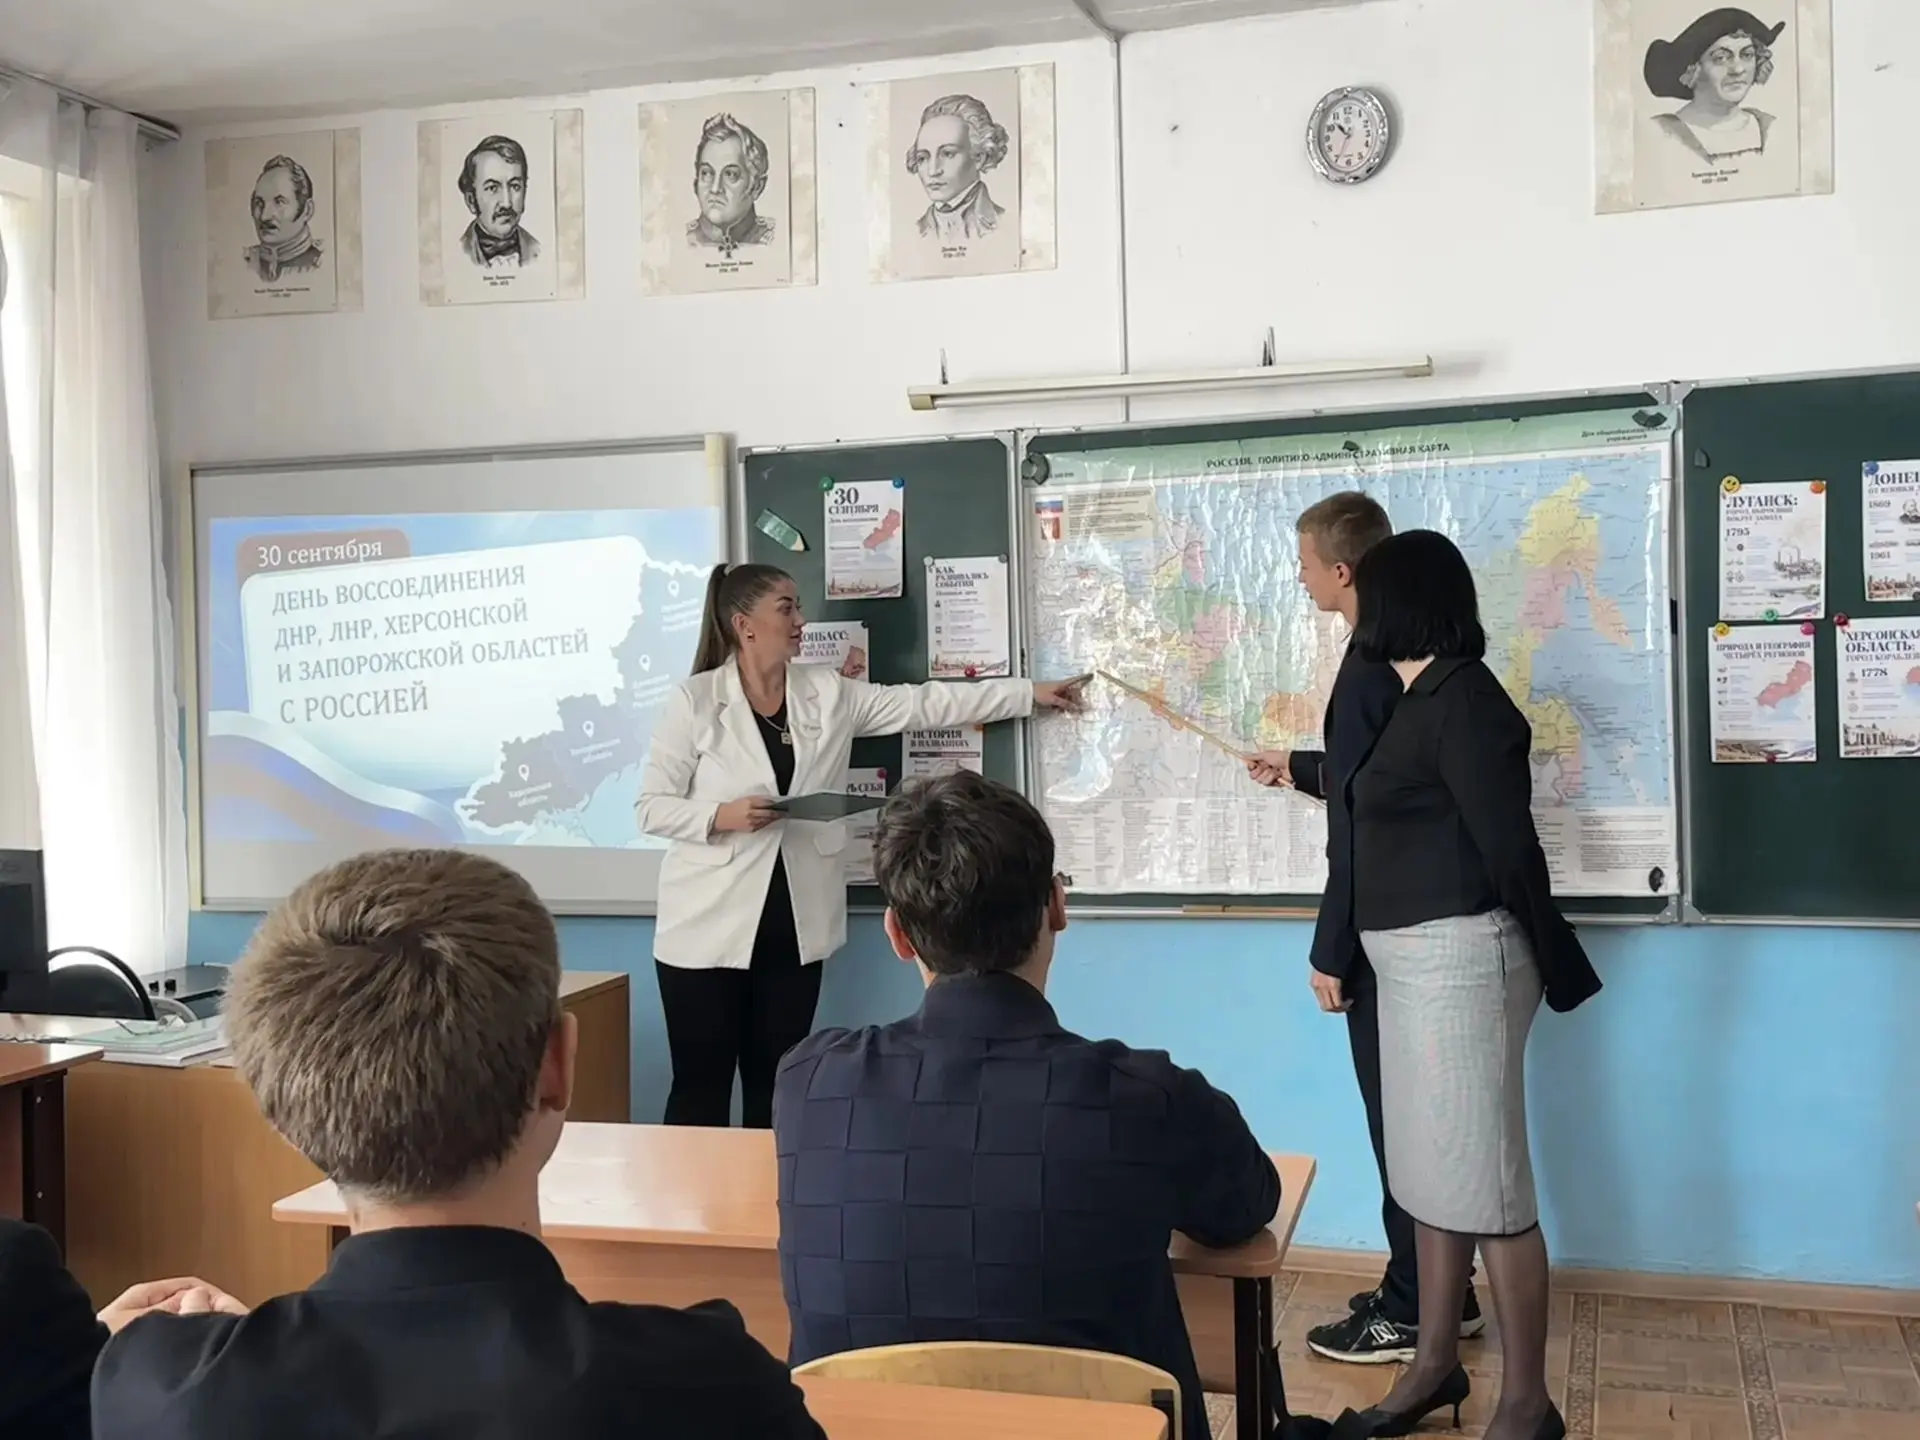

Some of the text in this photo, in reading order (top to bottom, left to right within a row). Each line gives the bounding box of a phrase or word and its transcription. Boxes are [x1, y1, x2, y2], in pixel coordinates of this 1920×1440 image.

[1418, 443, 1451, 453] КАРТА
[834, 487, 859, 505] 30
[1725, 494, 1799, 508] ЛУГАНСК:
[1726, 527, 1750, 537] 1795
[257, 539, 383, 567] 30 сентября
[271, 565, 527, 616] ДЕНЬ ВОССОЕДИНЕНИЯ
[274, 597, 529, 653] ДНР, ЛНР, ХЕРСОНСКОЙ
[1845, 641, 1915, 653] ОБЛАСТЬ:
[277, 631, 590, 684] И ЗАПОРОЖСКОЙ ОБЛАСТЕЙ
[1861, 668, 1889, 678] 1778
[279, 682, 429, 725] С РОССИЕЙ
